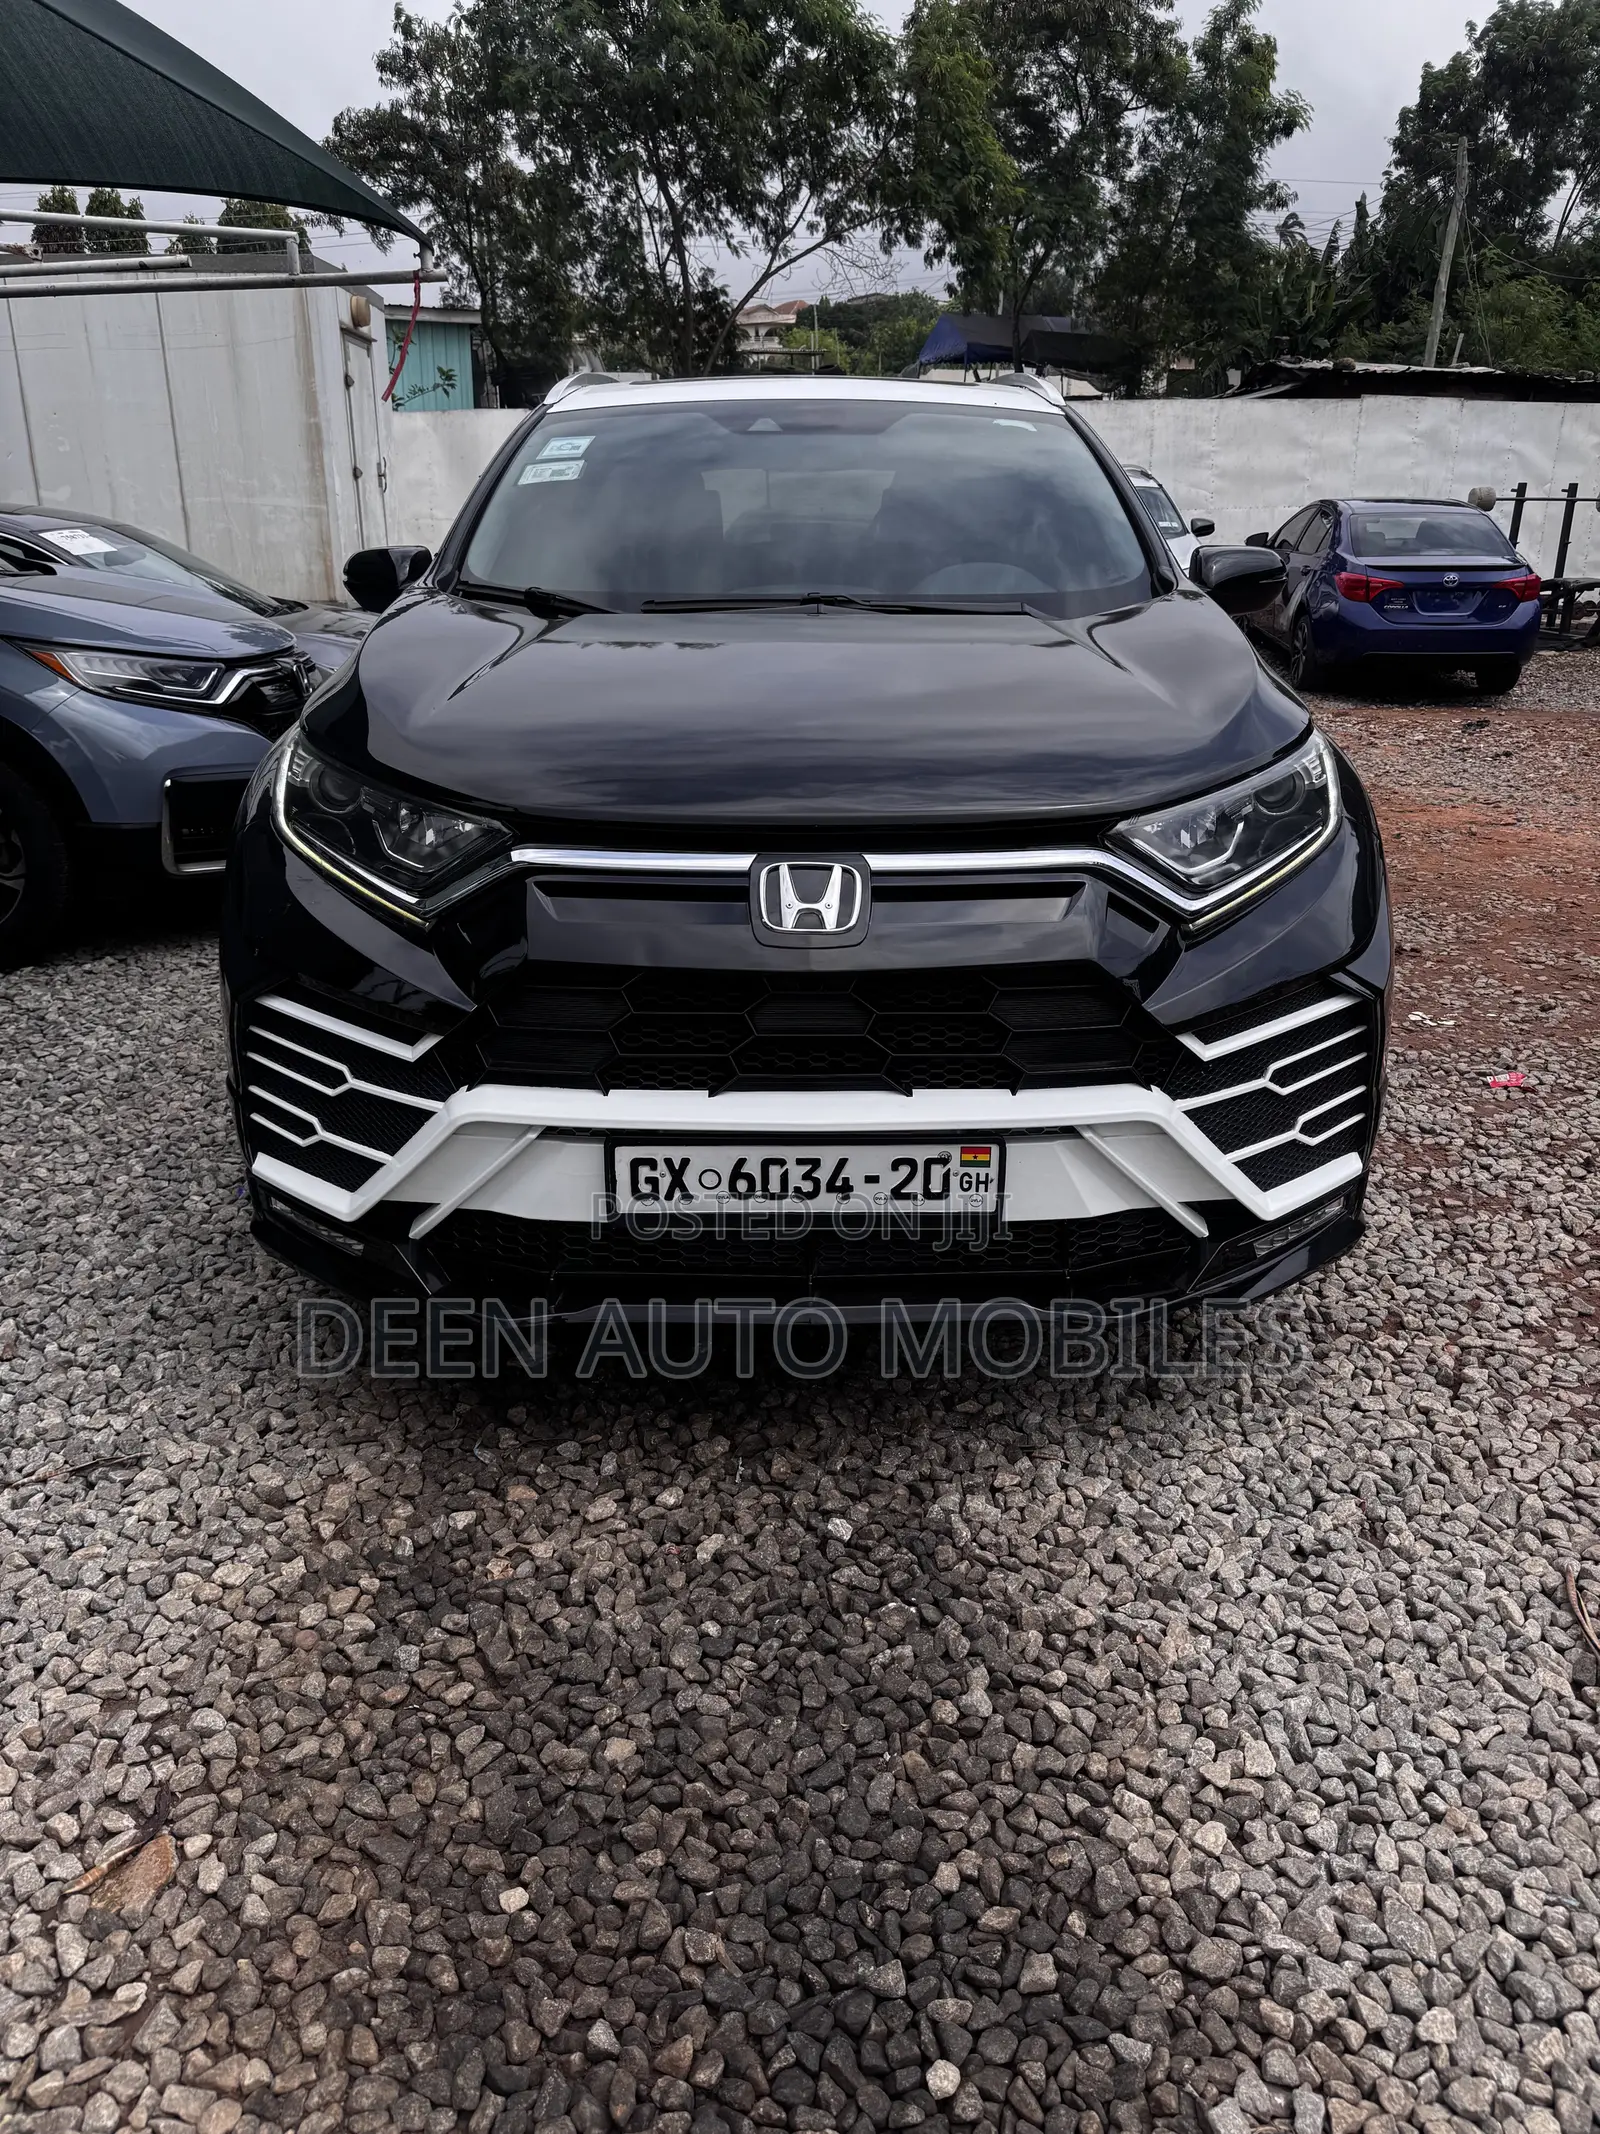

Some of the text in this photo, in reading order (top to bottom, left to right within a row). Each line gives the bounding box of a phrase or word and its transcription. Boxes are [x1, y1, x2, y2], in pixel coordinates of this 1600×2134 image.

[629, 1157, 951, 1201] GX 6034-20
[959, 1172, 990, 1193] GH
